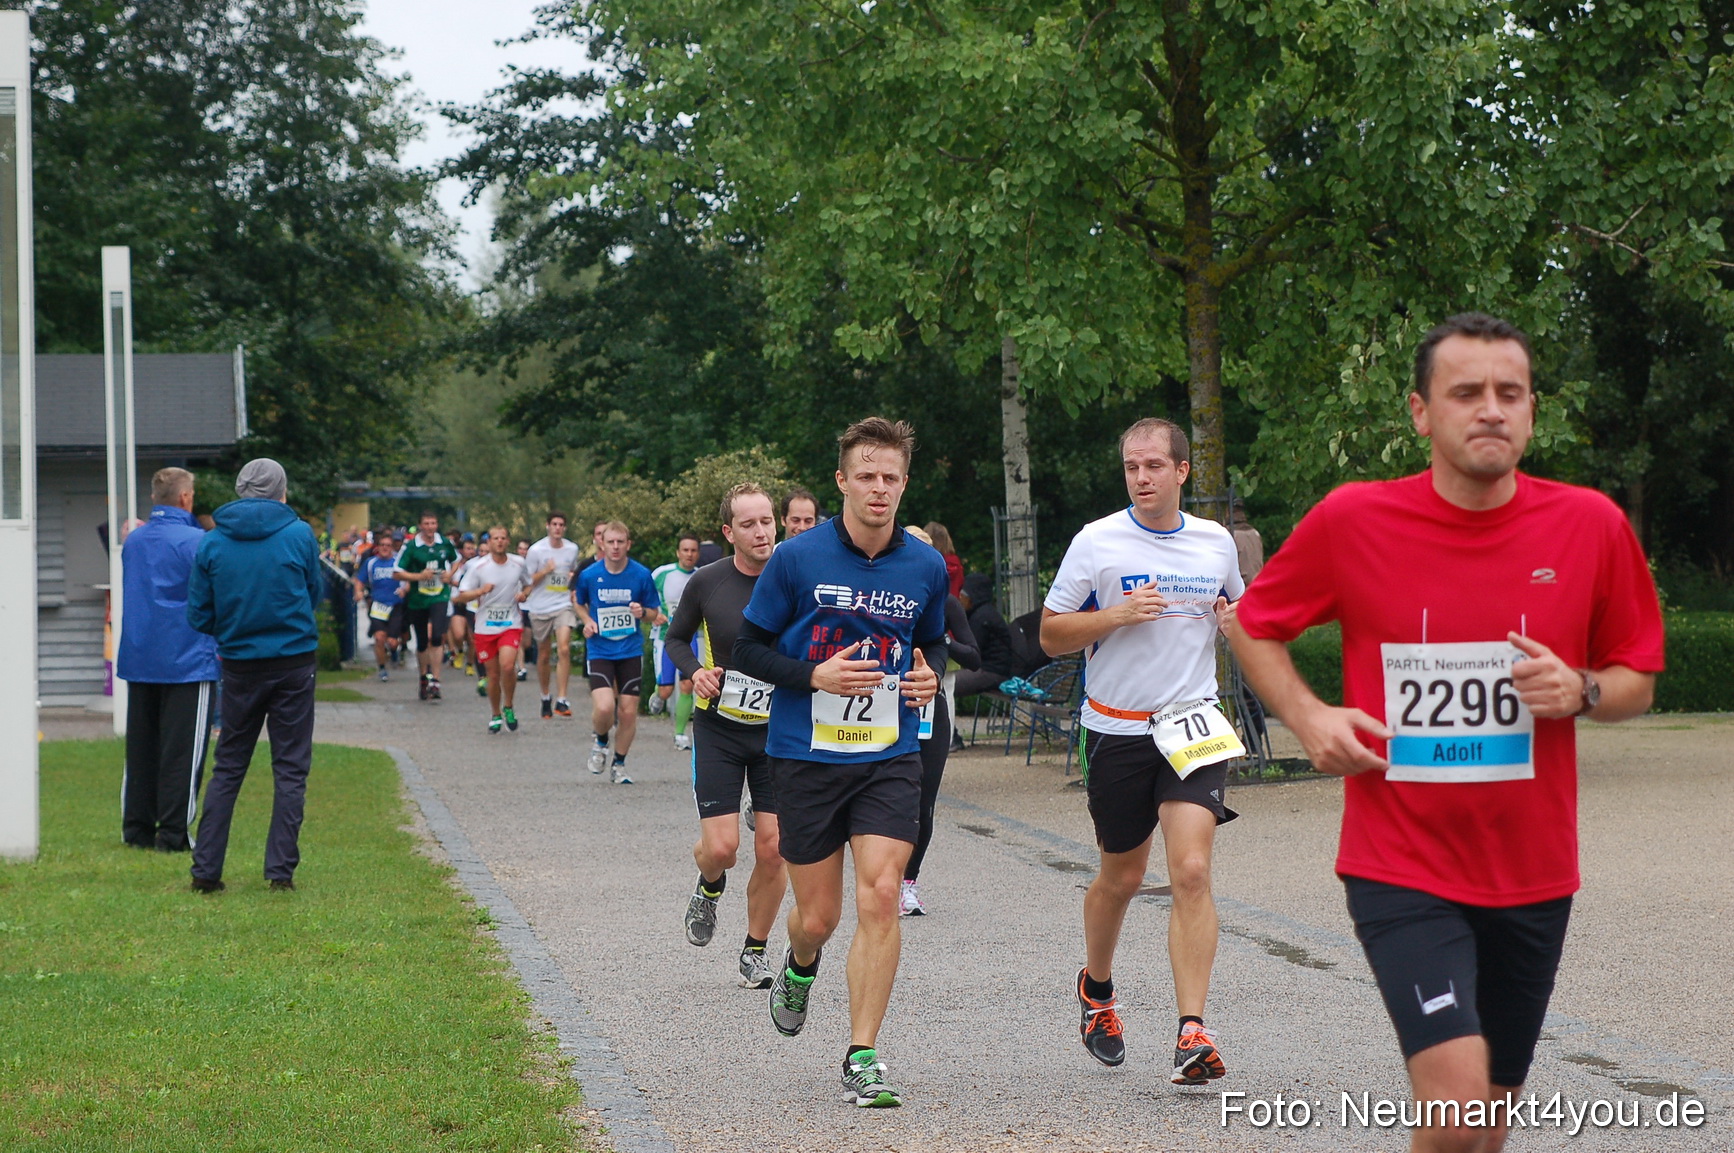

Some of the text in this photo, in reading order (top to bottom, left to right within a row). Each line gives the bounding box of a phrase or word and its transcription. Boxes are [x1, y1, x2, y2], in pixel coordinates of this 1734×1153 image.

[1156, 574, 1217, 584] Raiffeisenbank
[1173, 585, 1207, 595] Rothsee
[870, 590, 919, 610] HiRo
[487, 609, 510, 620] 2927
[869, 605, 892, 616] Run
[602, 614, 632, 628] 2759
[812, 624, 843, 642] BE A
[1386, 657, 1506, 671] PARTL Neumarkt
[726, 675, 749, 685] PARTL
[840, 695, 874, 722] 72
[1400, 677, 1520, 727] 2296
[1173, 713, 1211, 741] 70
[837, 729, 873, 742] Daniel
[1184, 740, 1228, 760] Matthias
[1433, 742, 1484, 762] Adolf
